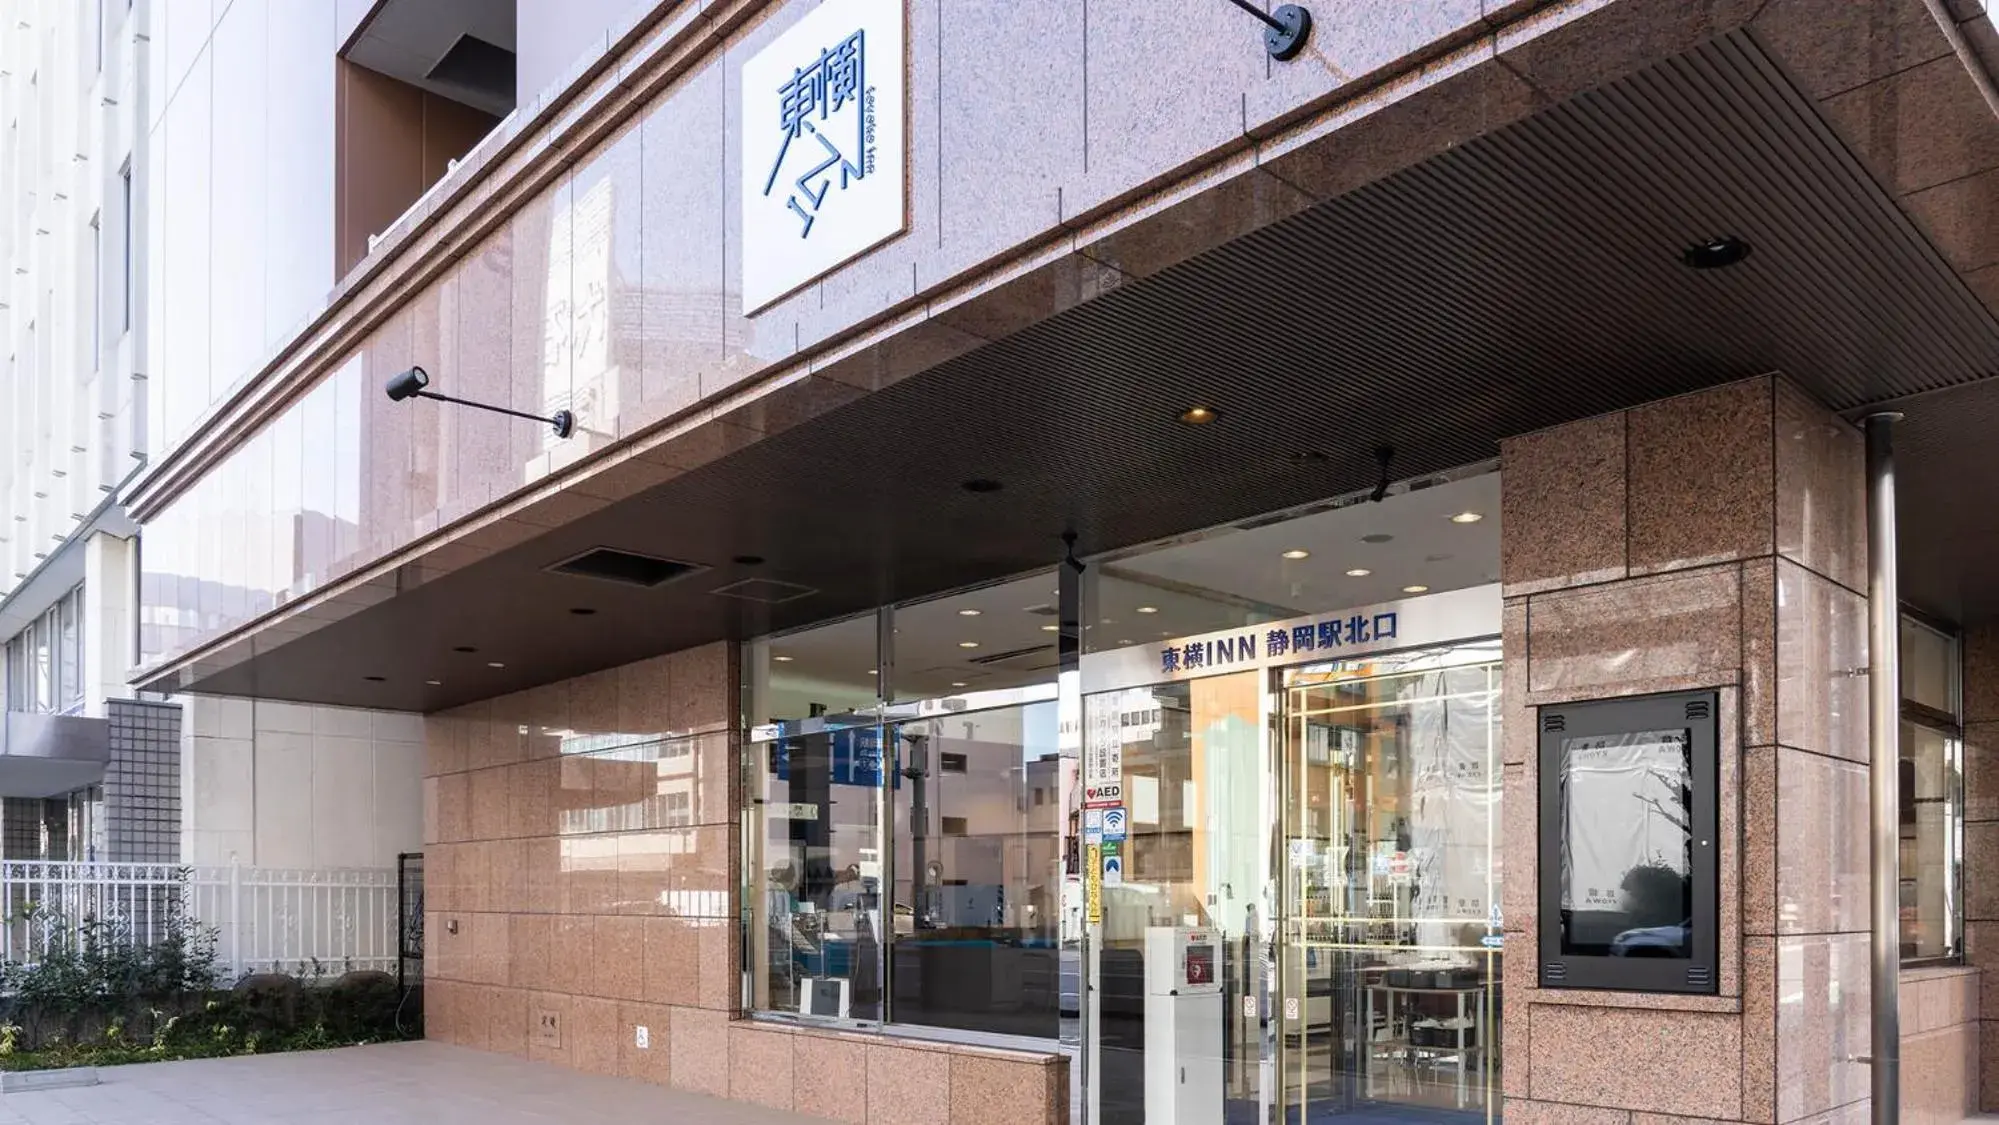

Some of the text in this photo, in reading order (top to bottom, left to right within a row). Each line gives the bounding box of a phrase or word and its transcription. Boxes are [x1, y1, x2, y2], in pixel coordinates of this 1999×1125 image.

[1161, 612, 1397, 673] 東横INN 静岡駅北口
[1096, 785, 1120, 798] AED
